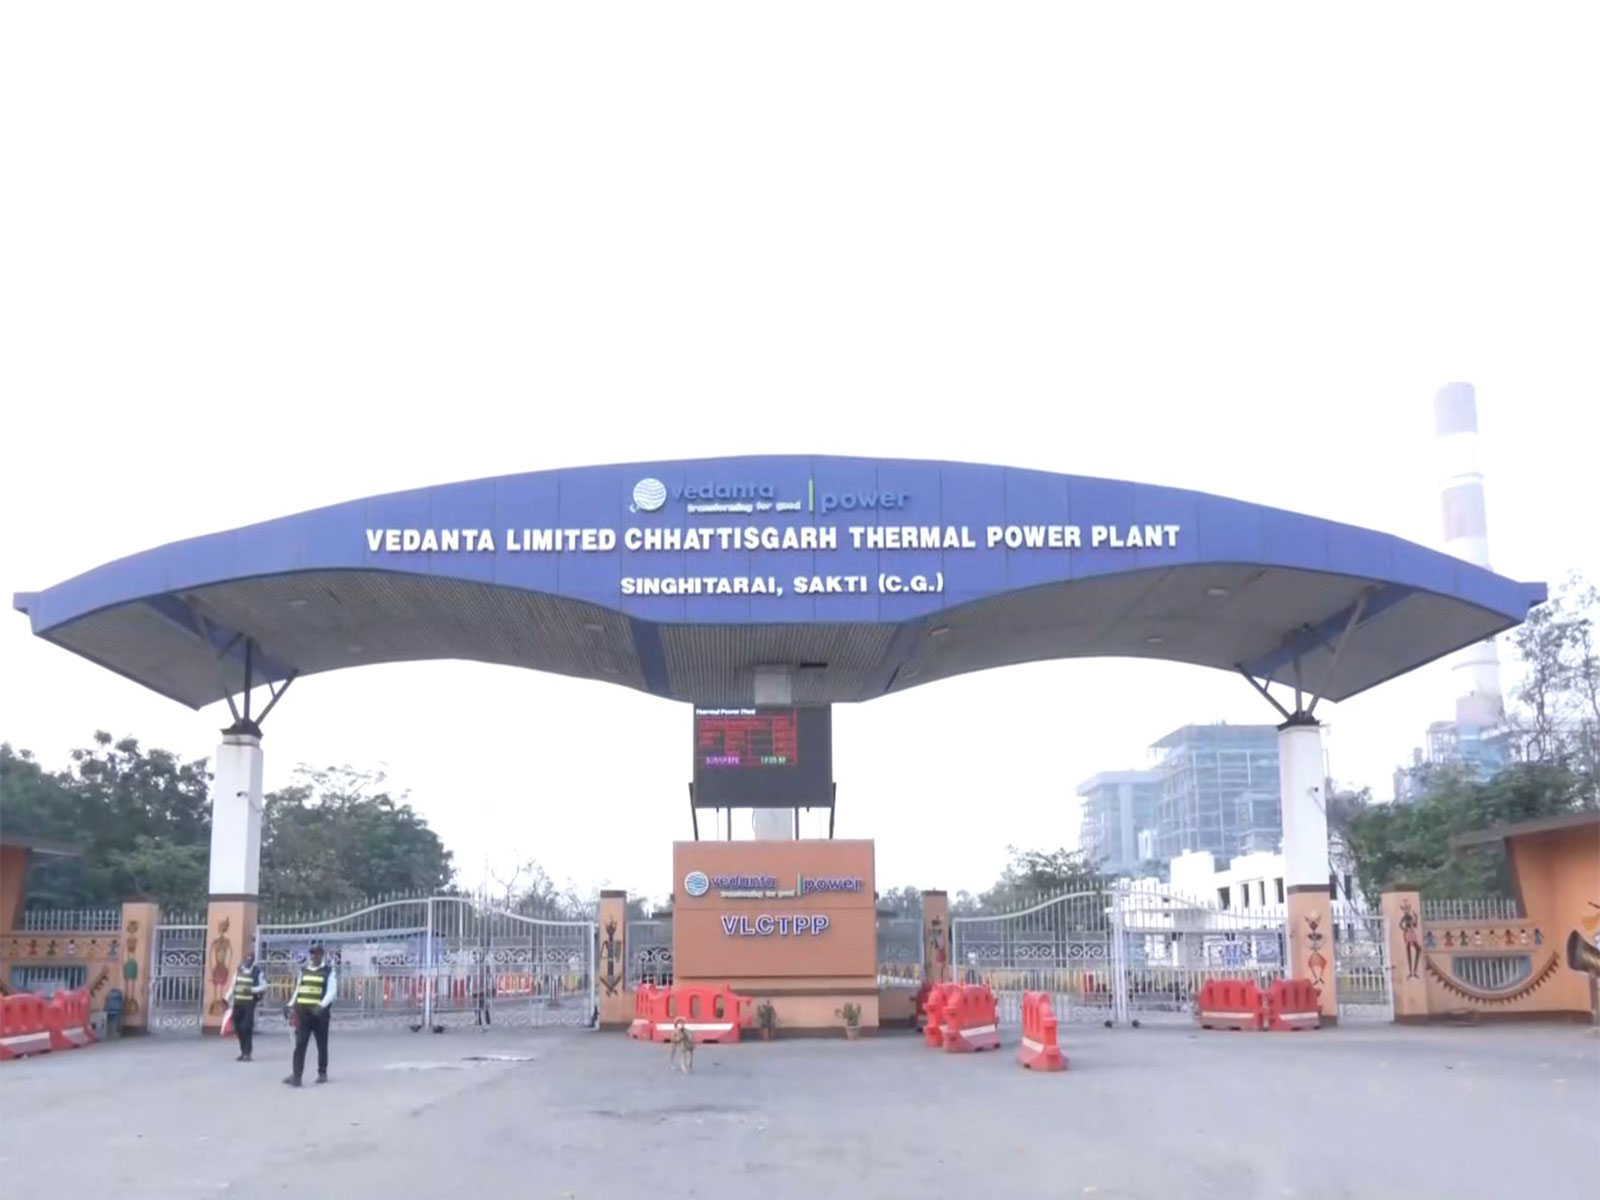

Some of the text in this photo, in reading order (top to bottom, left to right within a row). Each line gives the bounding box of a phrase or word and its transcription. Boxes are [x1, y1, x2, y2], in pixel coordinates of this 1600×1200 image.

[671, 480, 910, 515] vedanta power
[366, 524, 1180, 553] VEDANTA LIMITED CHHATTISGARH THERMAL POWER PLANT
[620, 572, 944, 597] SINGHITARAI, SAKTI (C.G.)
[710, 874, 776, 890] vedanta
[804, 877, 863, 895] power
[720, 914, 829, 936] VLCTPP
